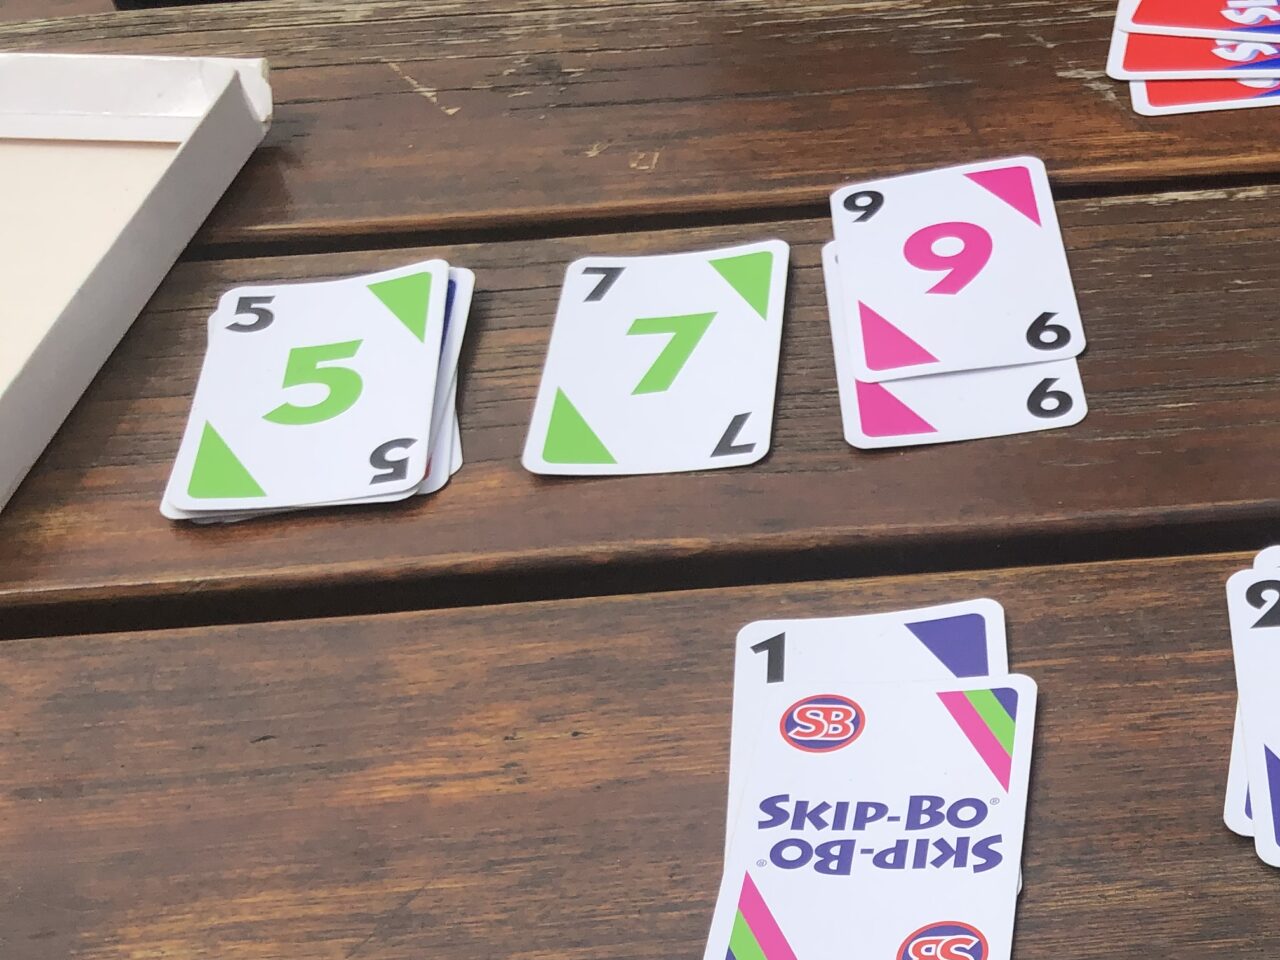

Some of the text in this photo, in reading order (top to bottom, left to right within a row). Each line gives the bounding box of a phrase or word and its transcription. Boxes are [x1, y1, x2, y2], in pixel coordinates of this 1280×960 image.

[843, 191, 884, 222] 9
[903, 222, 992, 294] 9
[582, 267, 625, 302] 7
[226, 296, 275, 332] 5
[627, 312, 716, 395] 7
[263, 340, 362, 425] 5
[710, 412, 756, 457] 7
[370, 438, 417, 484] 5
[750, 632, 785, 683] 1
[789, 703, 856, 741] SB
